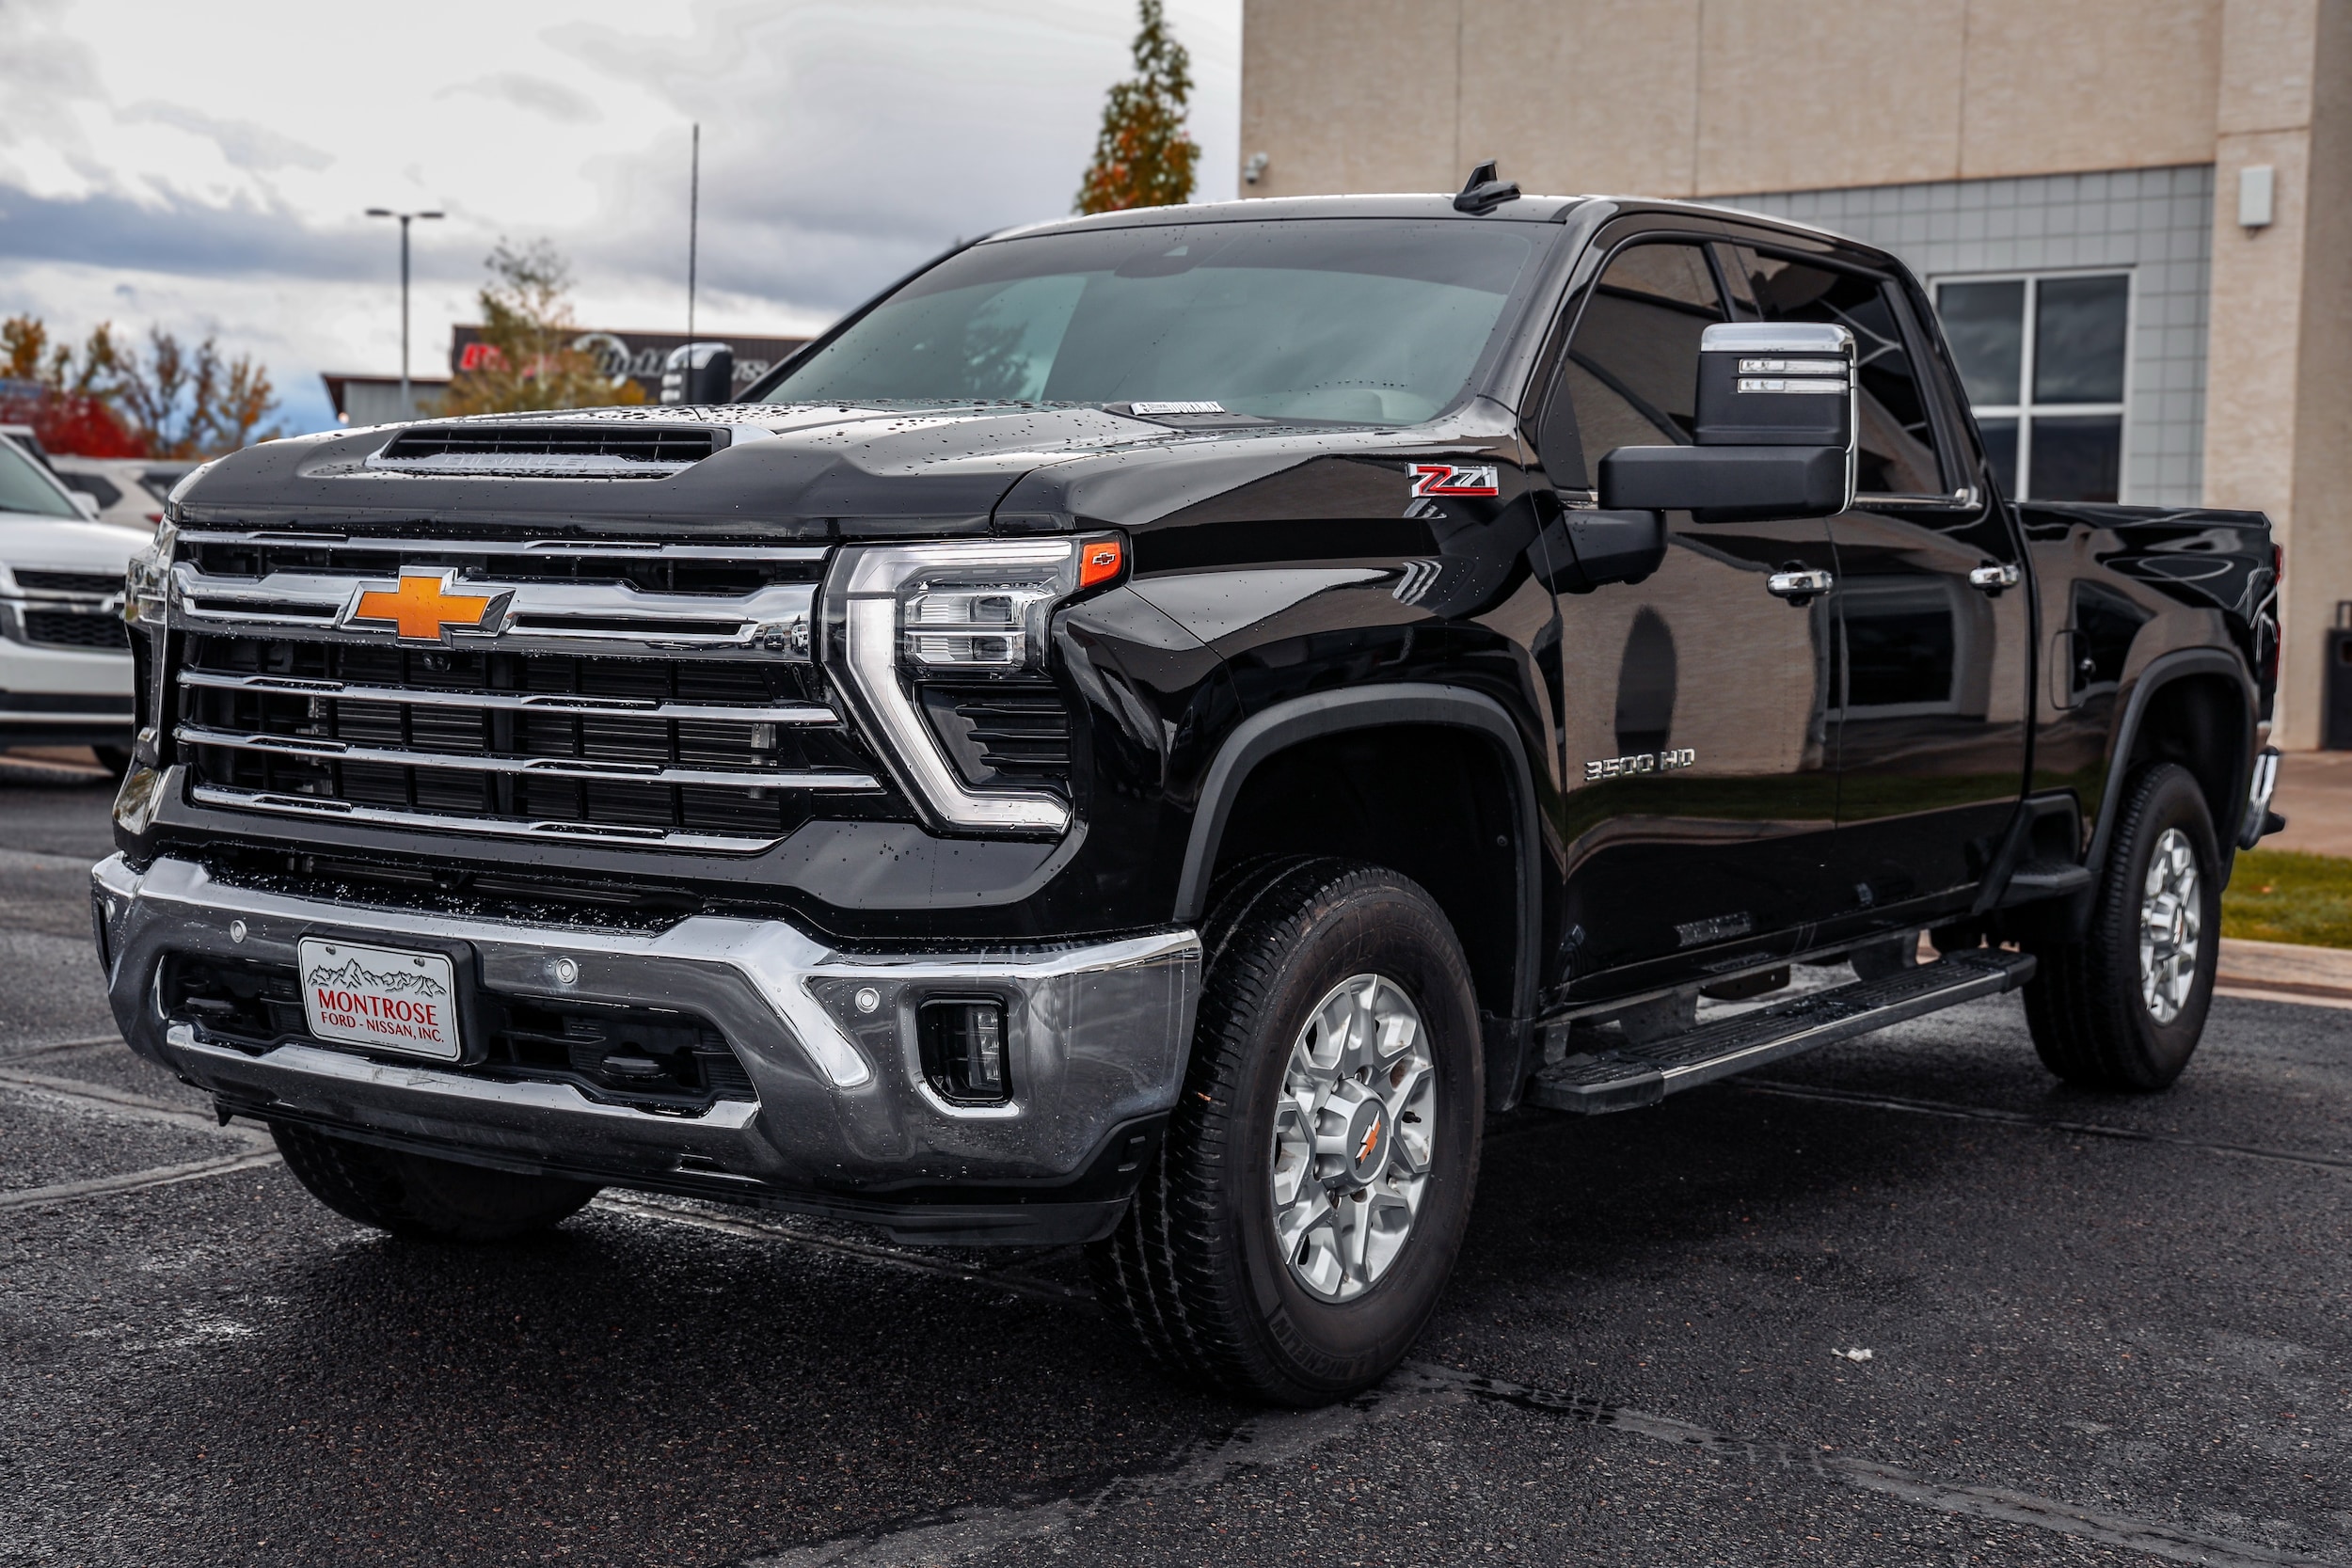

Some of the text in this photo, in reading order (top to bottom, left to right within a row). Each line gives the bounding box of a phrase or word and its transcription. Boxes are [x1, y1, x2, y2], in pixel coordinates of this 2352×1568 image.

[1405, 462, 1499, 499] Z71
[1584, 748, 1695, 782] 3500 HD
[317, 988, 438, 1026] MONTROSE
[321, 1011, 357, 1028] FORD
[366, 1019, 417, 1040] NISSAN,
[419, 1028, 444, 1043] INC.
